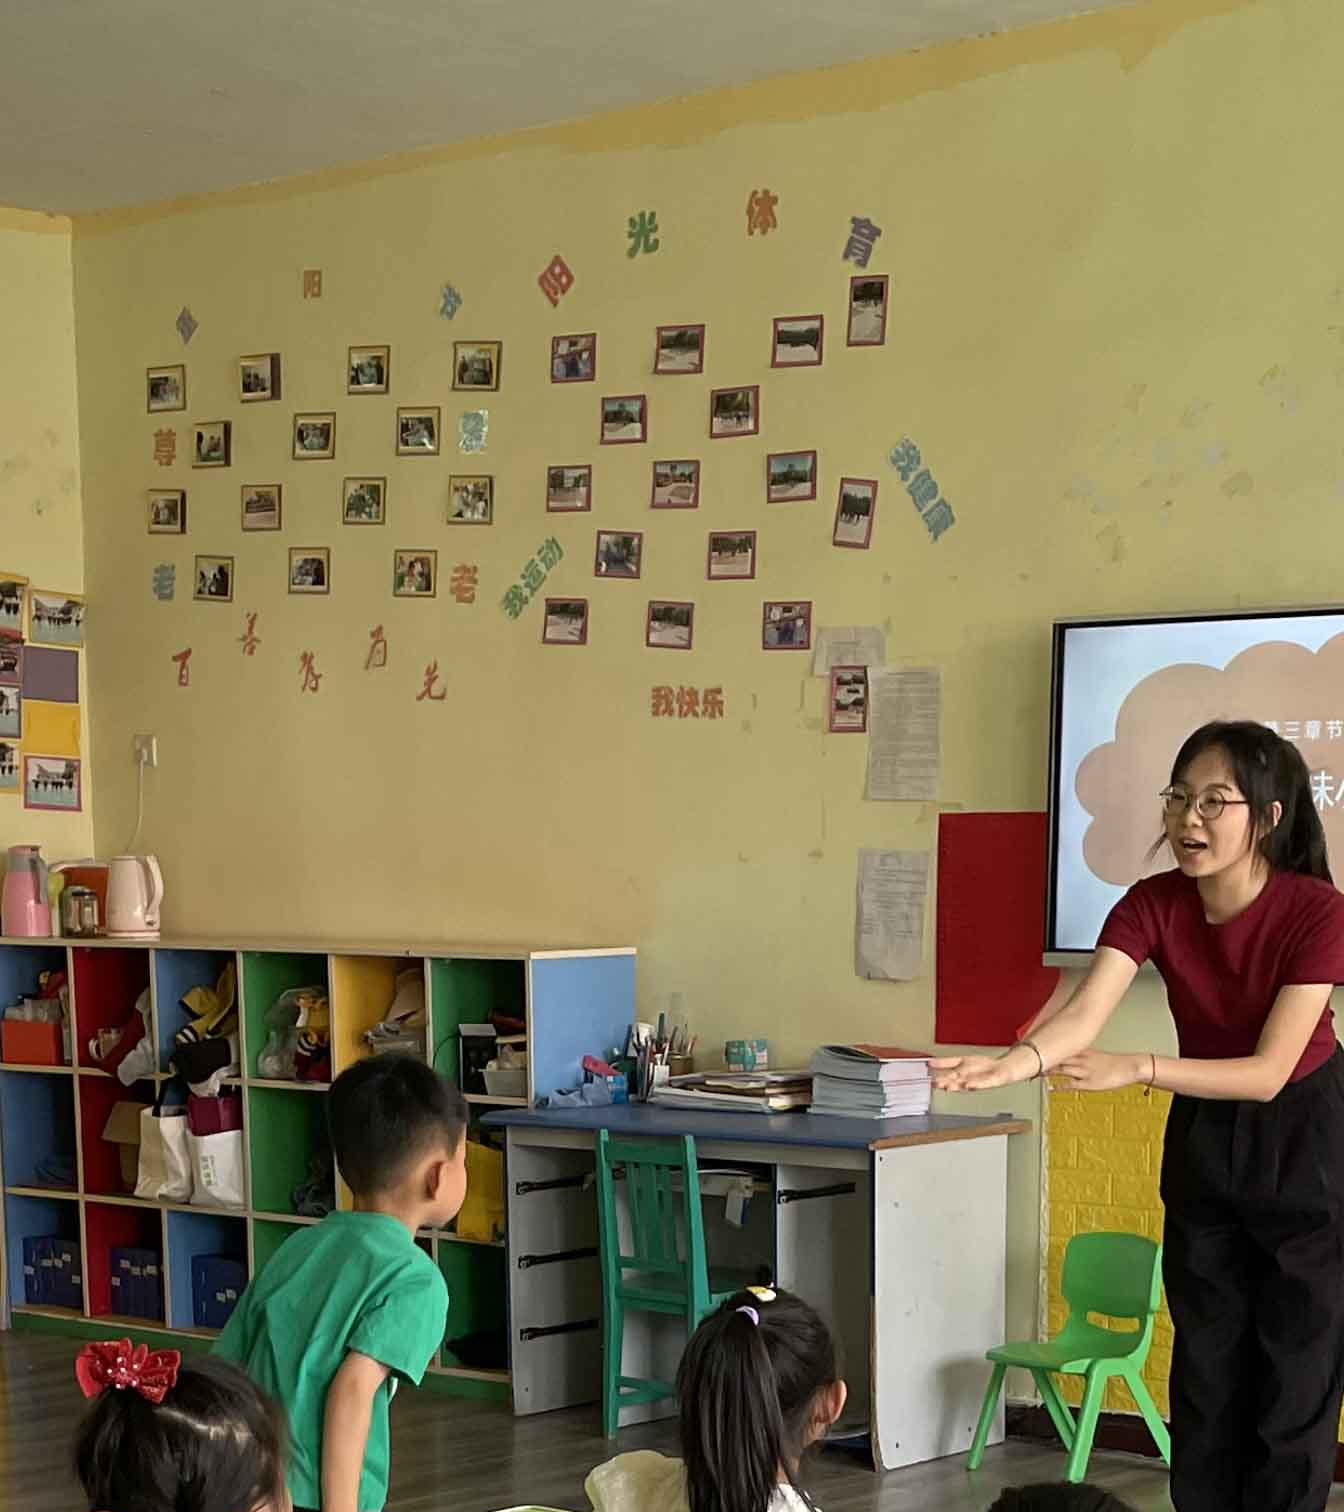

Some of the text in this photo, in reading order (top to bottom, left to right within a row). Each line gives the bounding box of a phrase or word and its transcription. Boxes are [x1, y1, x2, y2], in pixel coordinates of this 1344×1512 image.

[627, 210, 660, 259] 光
[651, 685, 725, 720] 我快乐
